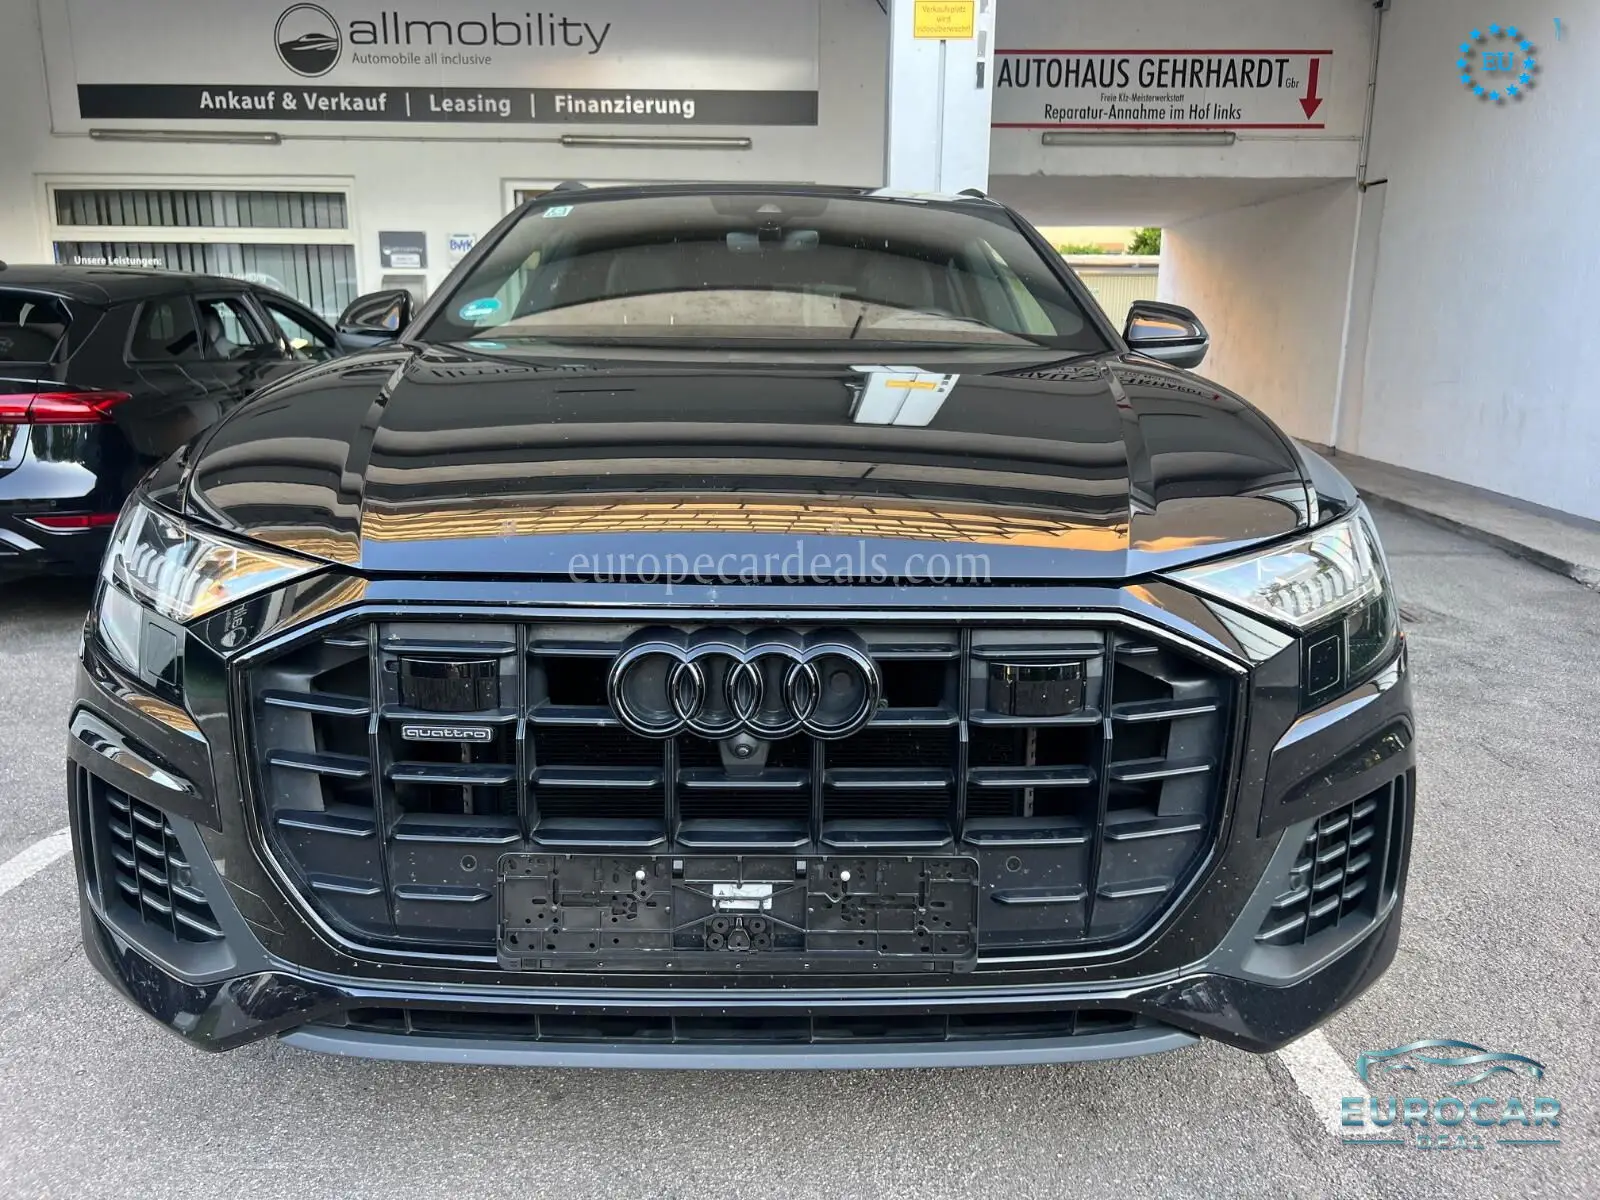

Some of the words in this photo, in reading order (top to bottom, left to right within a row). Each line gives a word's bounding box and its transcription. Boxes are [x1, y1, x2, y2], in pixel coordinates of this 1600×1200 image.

[349, 11, 612, 55] allmobility
[352, 52, 422, 65] Automobile
[424, 53, 439, 65] all
[441, 53, 492, 66] inclusive
[996, 58, 1130, 89] AUTOHAUS
[1138, 58, 1290, 89] GEHRHARDT
[1285, 77, 1300, 89] Gbr
[200, 92, 275, 111] Ankauf
[282, 93, 298, 111] &
[303, 92, 388, 112] Verkauf
[429, 94, 511, 116] Leasing
[555, 95, 696, 118] Finanzierung
[1100, 92, 1117, 102] Freie
[1044, 103, 1166, 122] Reparatur-Annahme
[1169, 104, 1185, 120] im
[1189, 104, 1211, 122] Hof
[1213, 103, 1242, 120] links
[73, 255, 107, 265] Unsere
[108, 255, 162, 267] Leistungen:
[406, 729, 486, 739] quattro
